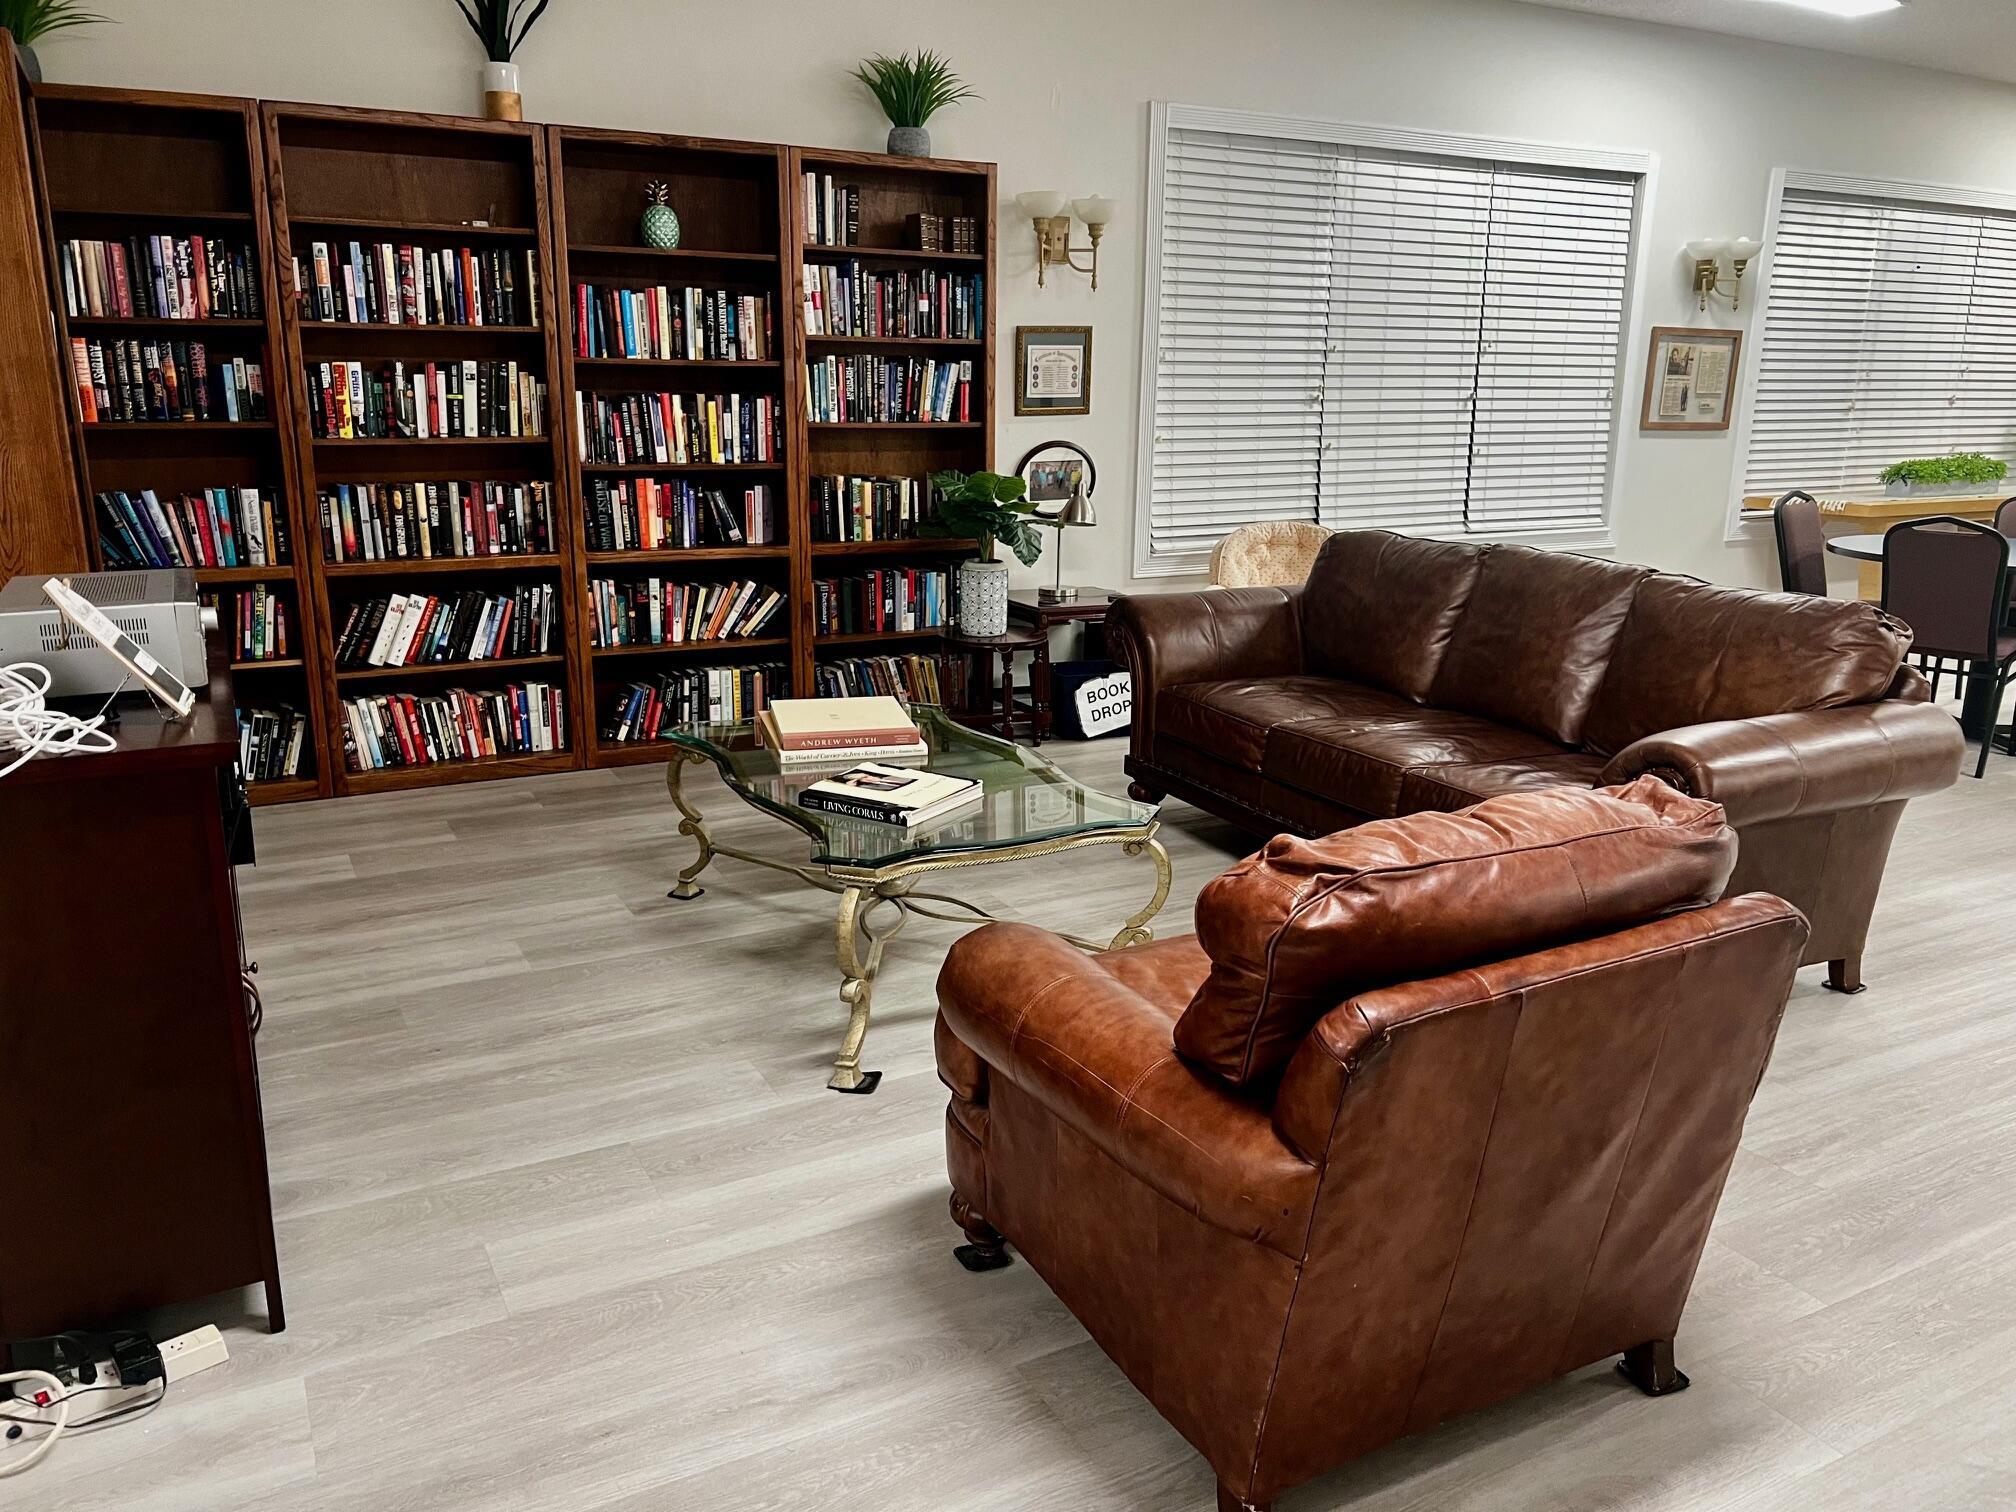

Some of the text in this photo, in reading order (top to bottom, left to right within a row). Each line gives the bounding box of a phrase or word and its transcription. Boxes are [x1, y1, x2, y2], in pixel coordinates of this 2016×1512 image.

[88, 344, 106, 385] AUTOPSY
[350, 370, 360, 397] Griffin
[896, 366, 904, 414] DREAMLAND
[323, 388, 336, 417] Special
[325, 418, 336, 433] Ops
[595, 480, 609, 514] HOUSE
[406, 503, 414, 520] FIRM
[278, 531, 286, 552] AKIN
[600, 525, 612, 549] WAR
[820, 592, 828, 625] Dictionary
[1087, 681, 1130, 704] BOOK
[1091, 700, 1131, 722] DROP
[800, 736, 877, 748] ANDREW WYETH
[823, 800, 851, 814] LIVING
[852, 806, 884, 820] CORALS
